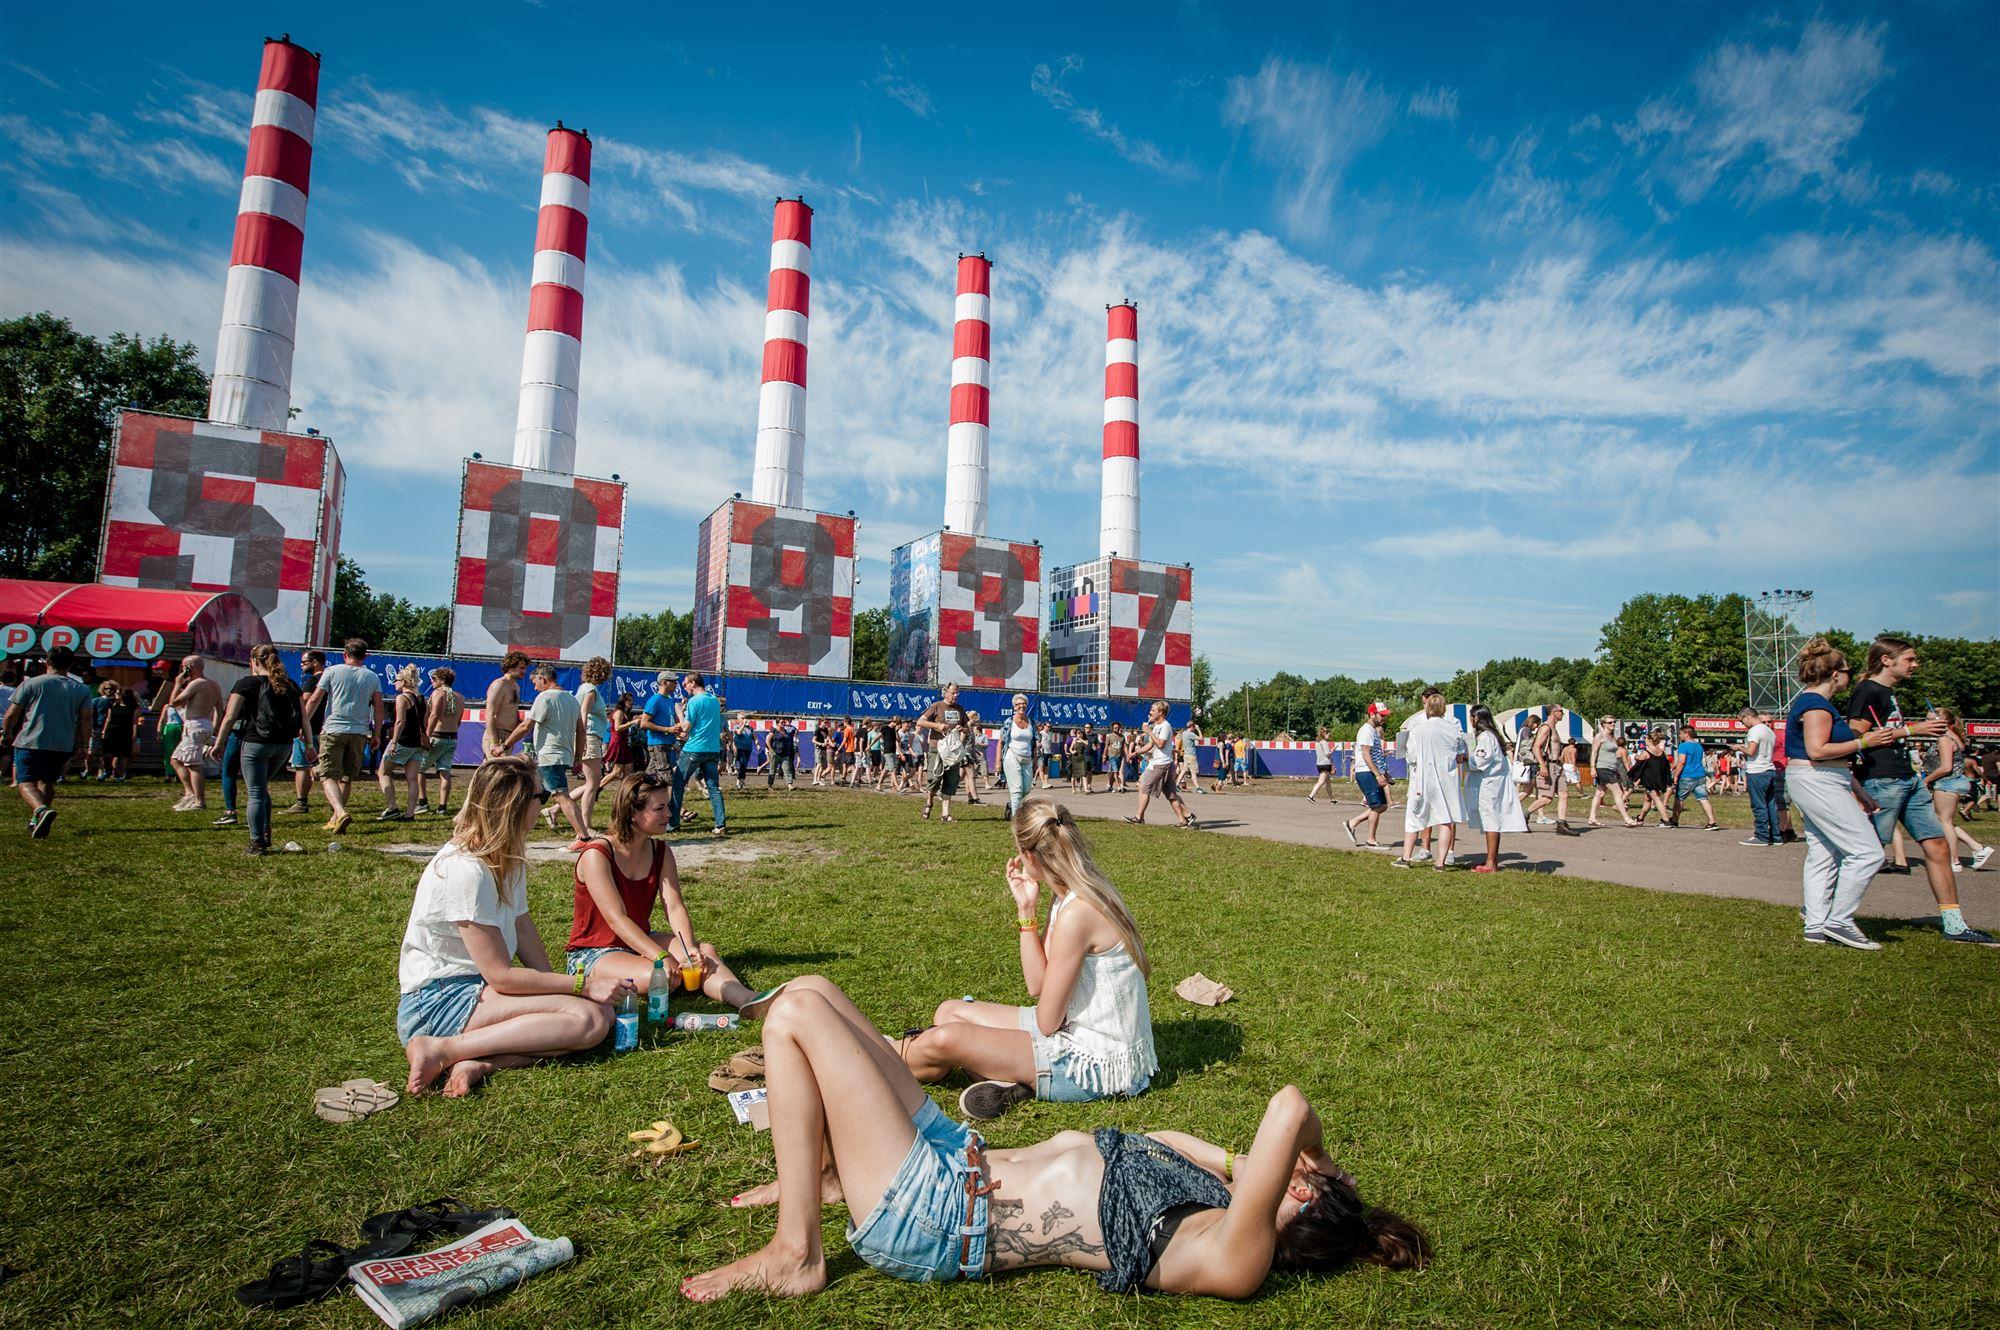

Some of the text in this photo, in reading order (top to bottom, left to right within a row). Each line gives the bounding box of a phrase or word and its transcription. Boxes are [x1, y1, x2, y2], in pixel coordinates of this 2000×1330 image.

[746, 516, 836, 666] 9
[955, 546, 1024, 679] 3
[1123, 568, 1180, 688] 7
[807, 701, 822, 710] EXIT
[1001, 708, 1013, 716] EXIT
[365, 1251, 458, 1277] DAILY
